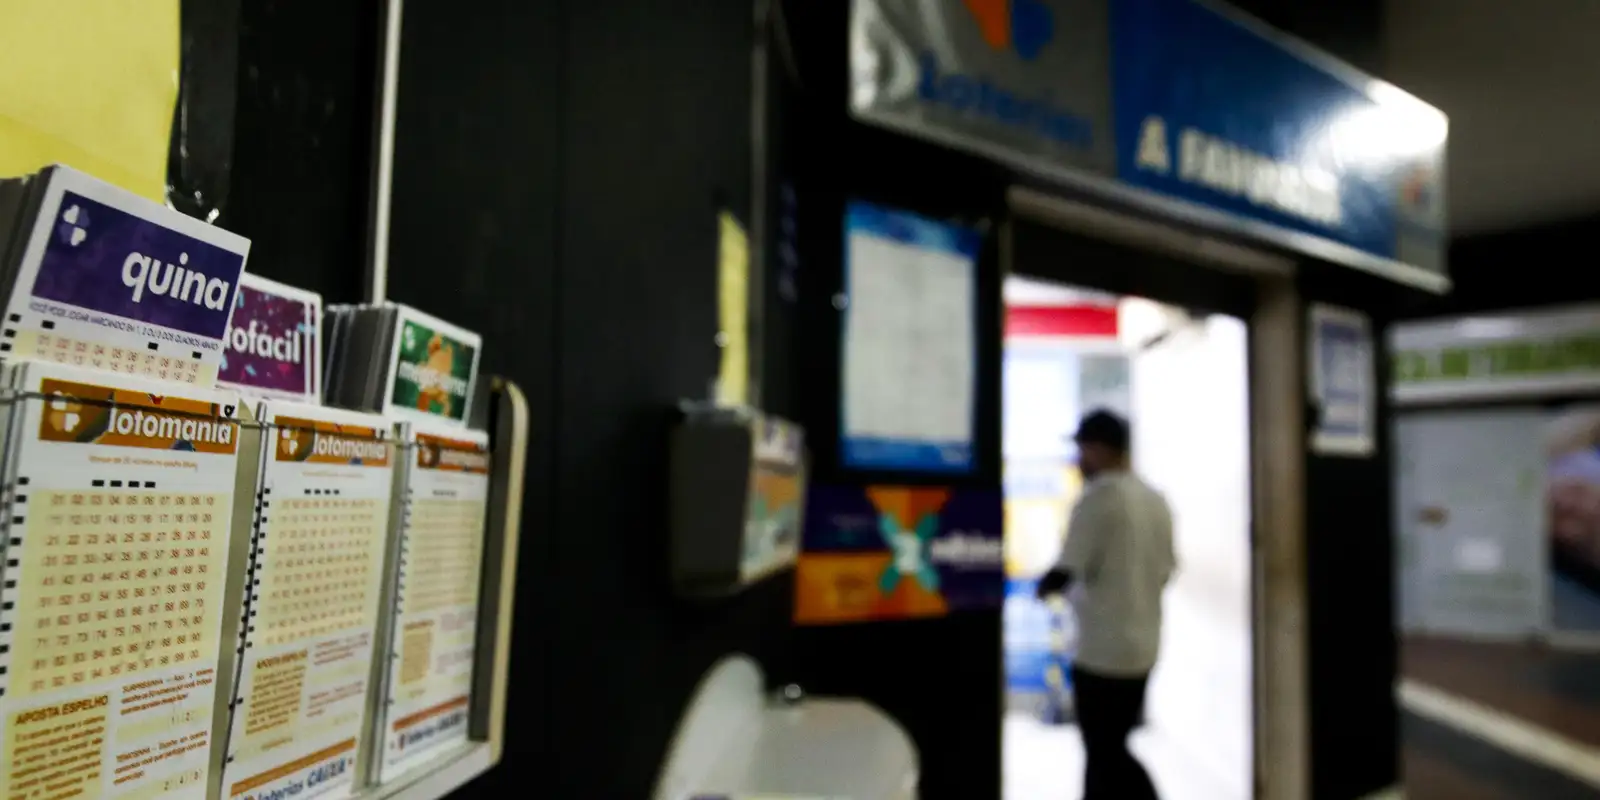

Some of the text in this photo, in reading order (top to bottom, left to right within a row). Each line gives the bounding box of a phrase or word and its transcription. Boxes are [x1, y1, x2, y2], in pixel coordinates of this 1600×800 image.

[1133, 114, 1171, 174] A
[121, 252, 230, 311] quina
[108, 407, 231, 444] lotomania
[313, 432, 385, 460] lotomania
[15, 706, 60, 725] APOSTA
[62, 695, 109, 716] ESPELHO
